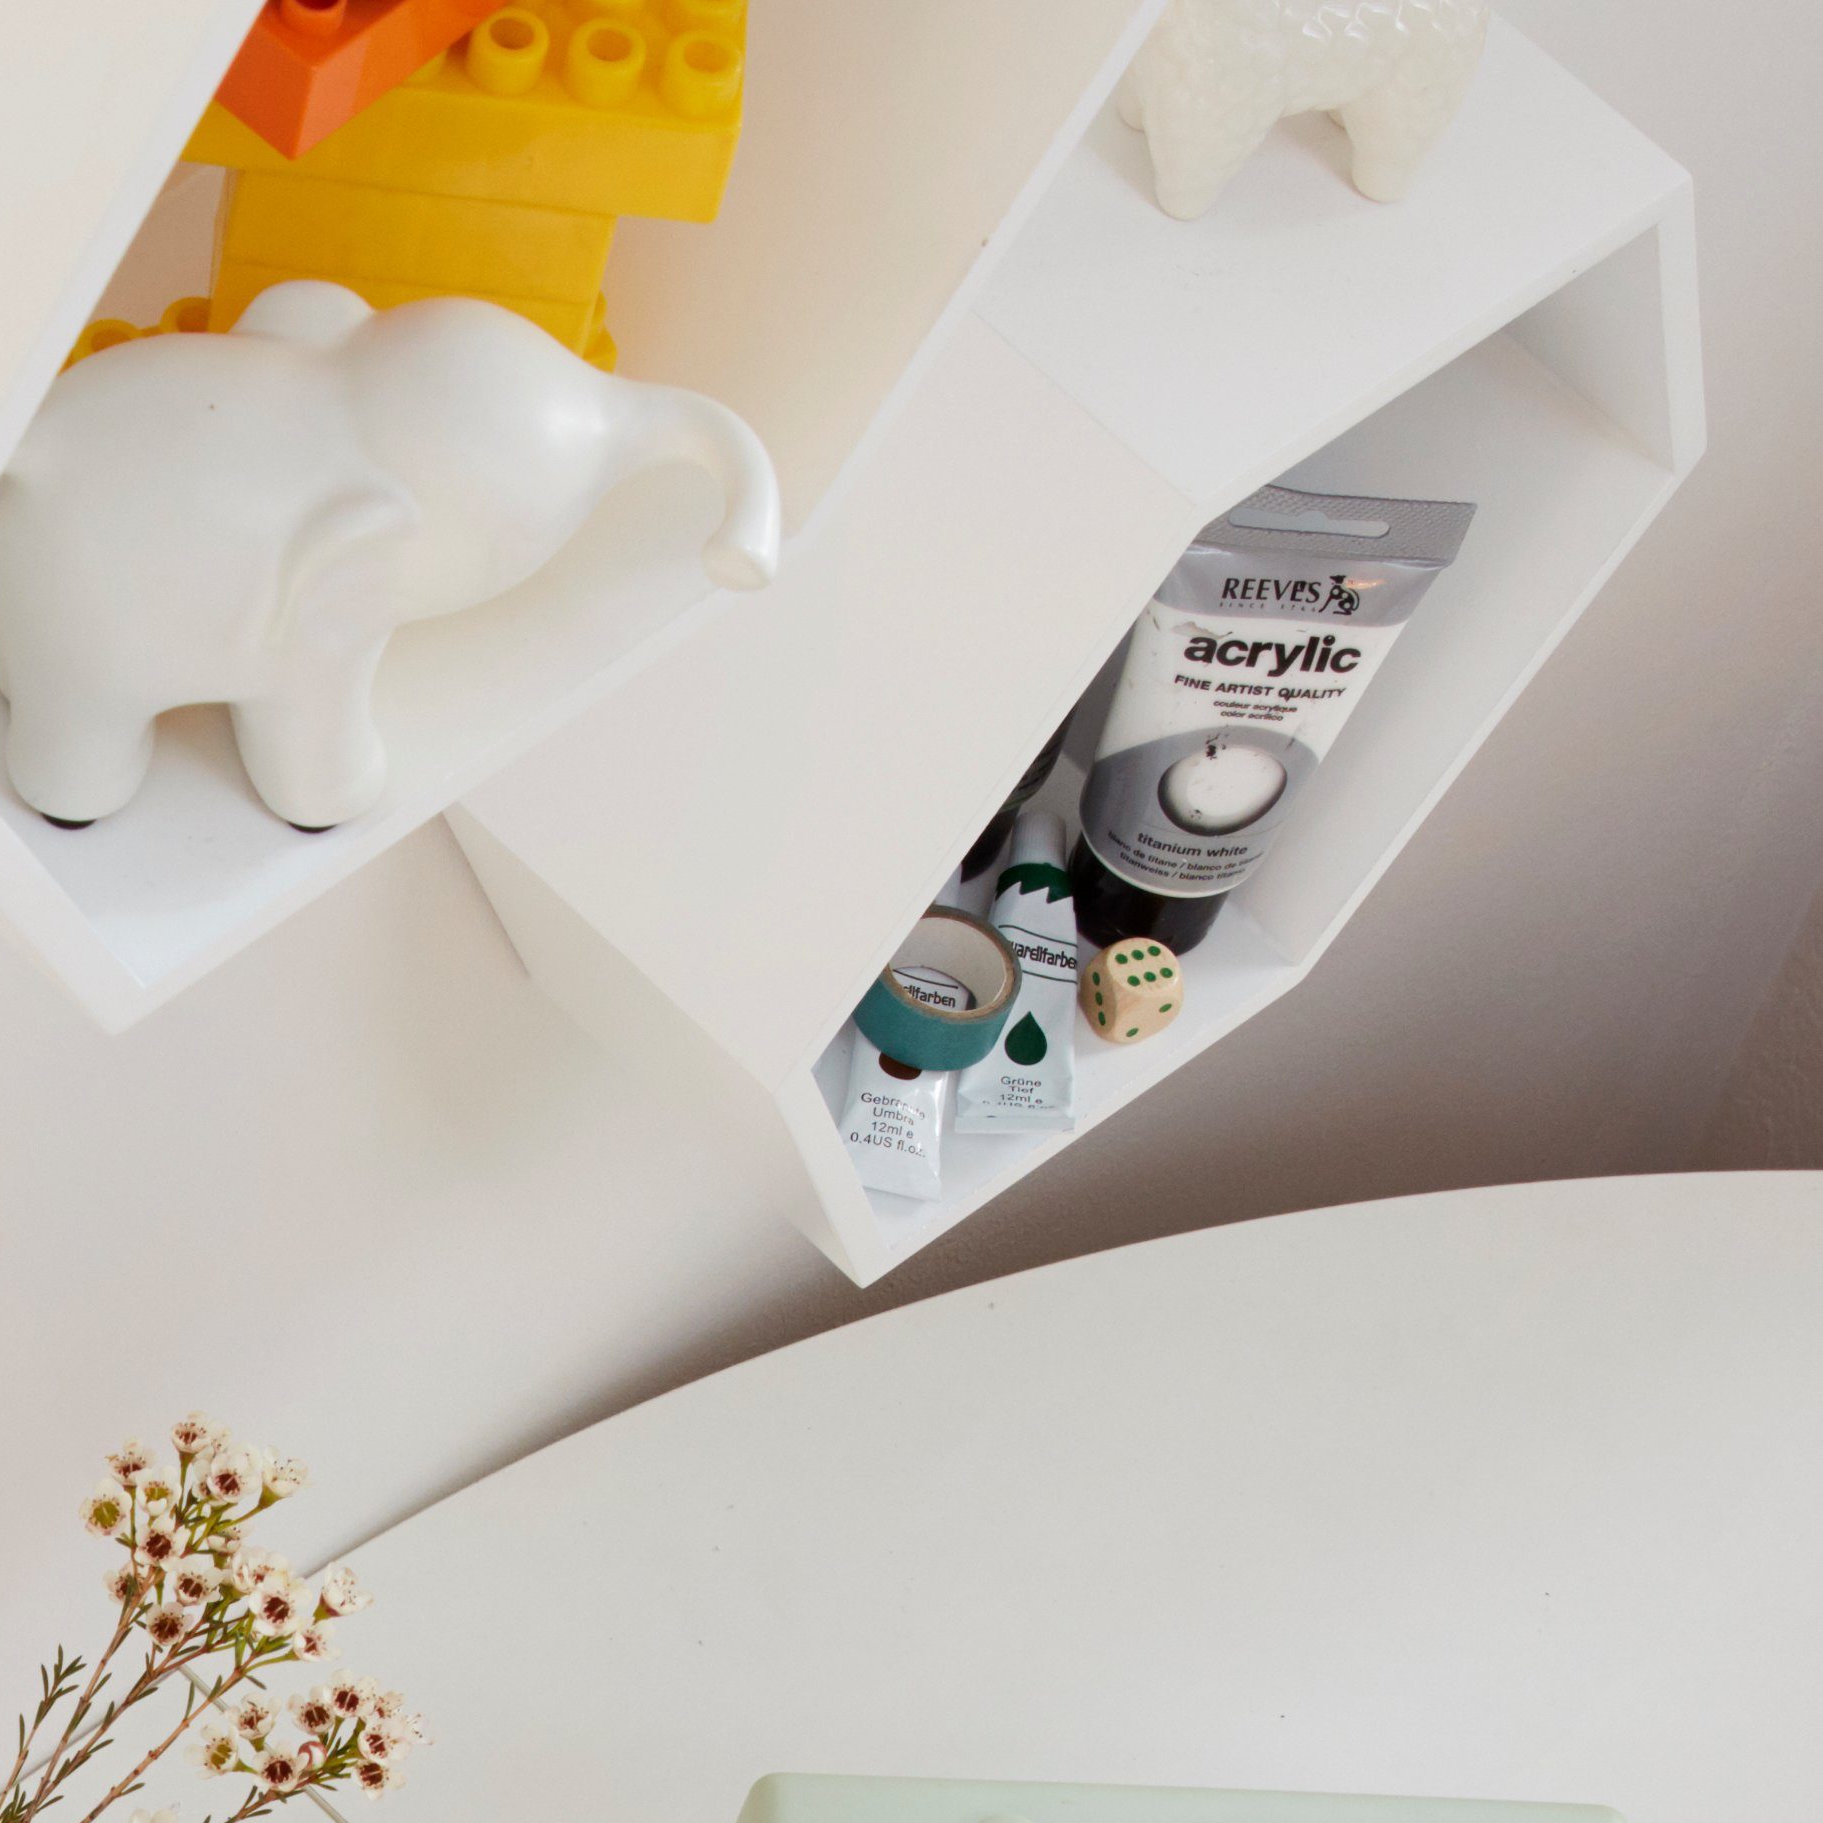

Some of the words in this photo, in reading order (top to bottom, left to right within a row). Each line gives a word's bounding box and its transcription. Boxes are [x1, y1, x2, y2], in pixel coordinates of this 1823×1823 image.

[1220, 577, 1322, 604] REEVES
[1183, 634, 1362, 678] acrylic
[1174, 674, 1212, 691] FINE
[1215, 682, 1274, 698] ARTIST
[1278, 687, 1346, 702] QUALITY
[1137, 832, 1202, 857] titanium
[1206, 845, 1249, 858] white
[1119, 851, 1170, 878] titanweiss
[1000, 1075, 1042, 1088] Grüne
[871, 1121, 903, 1136] 12ml
[872, 1107, 915, 1126] Umbra
